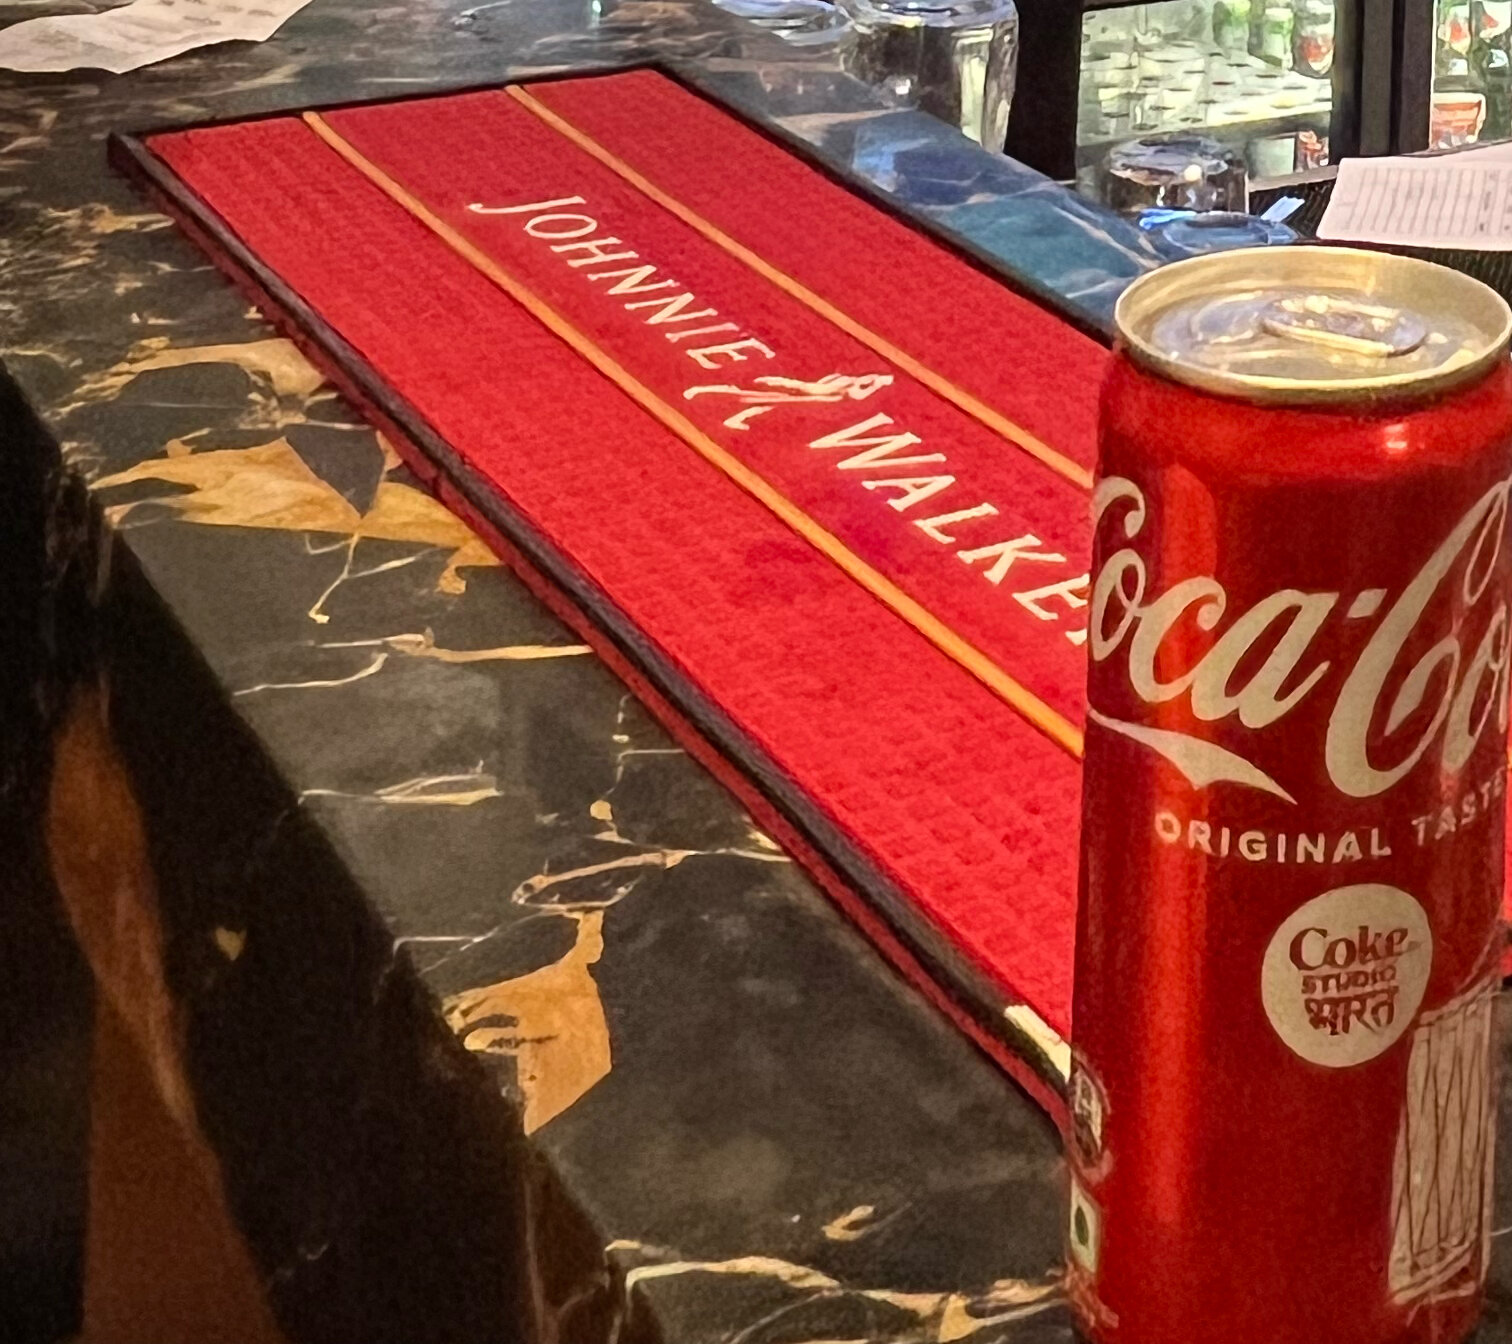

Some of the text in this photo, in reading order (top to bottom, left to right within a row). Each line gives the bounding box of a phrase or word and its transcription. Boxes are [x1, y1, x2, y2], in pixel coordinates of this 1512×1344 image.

[466, 196, 1090, 646] JOHNNIE WALKE
[1154, 813, 1392, 864] ORIGINAL
[1288, 925, 1410, 971] Coke
[1301, 965, 1397, 994] STUDIO
